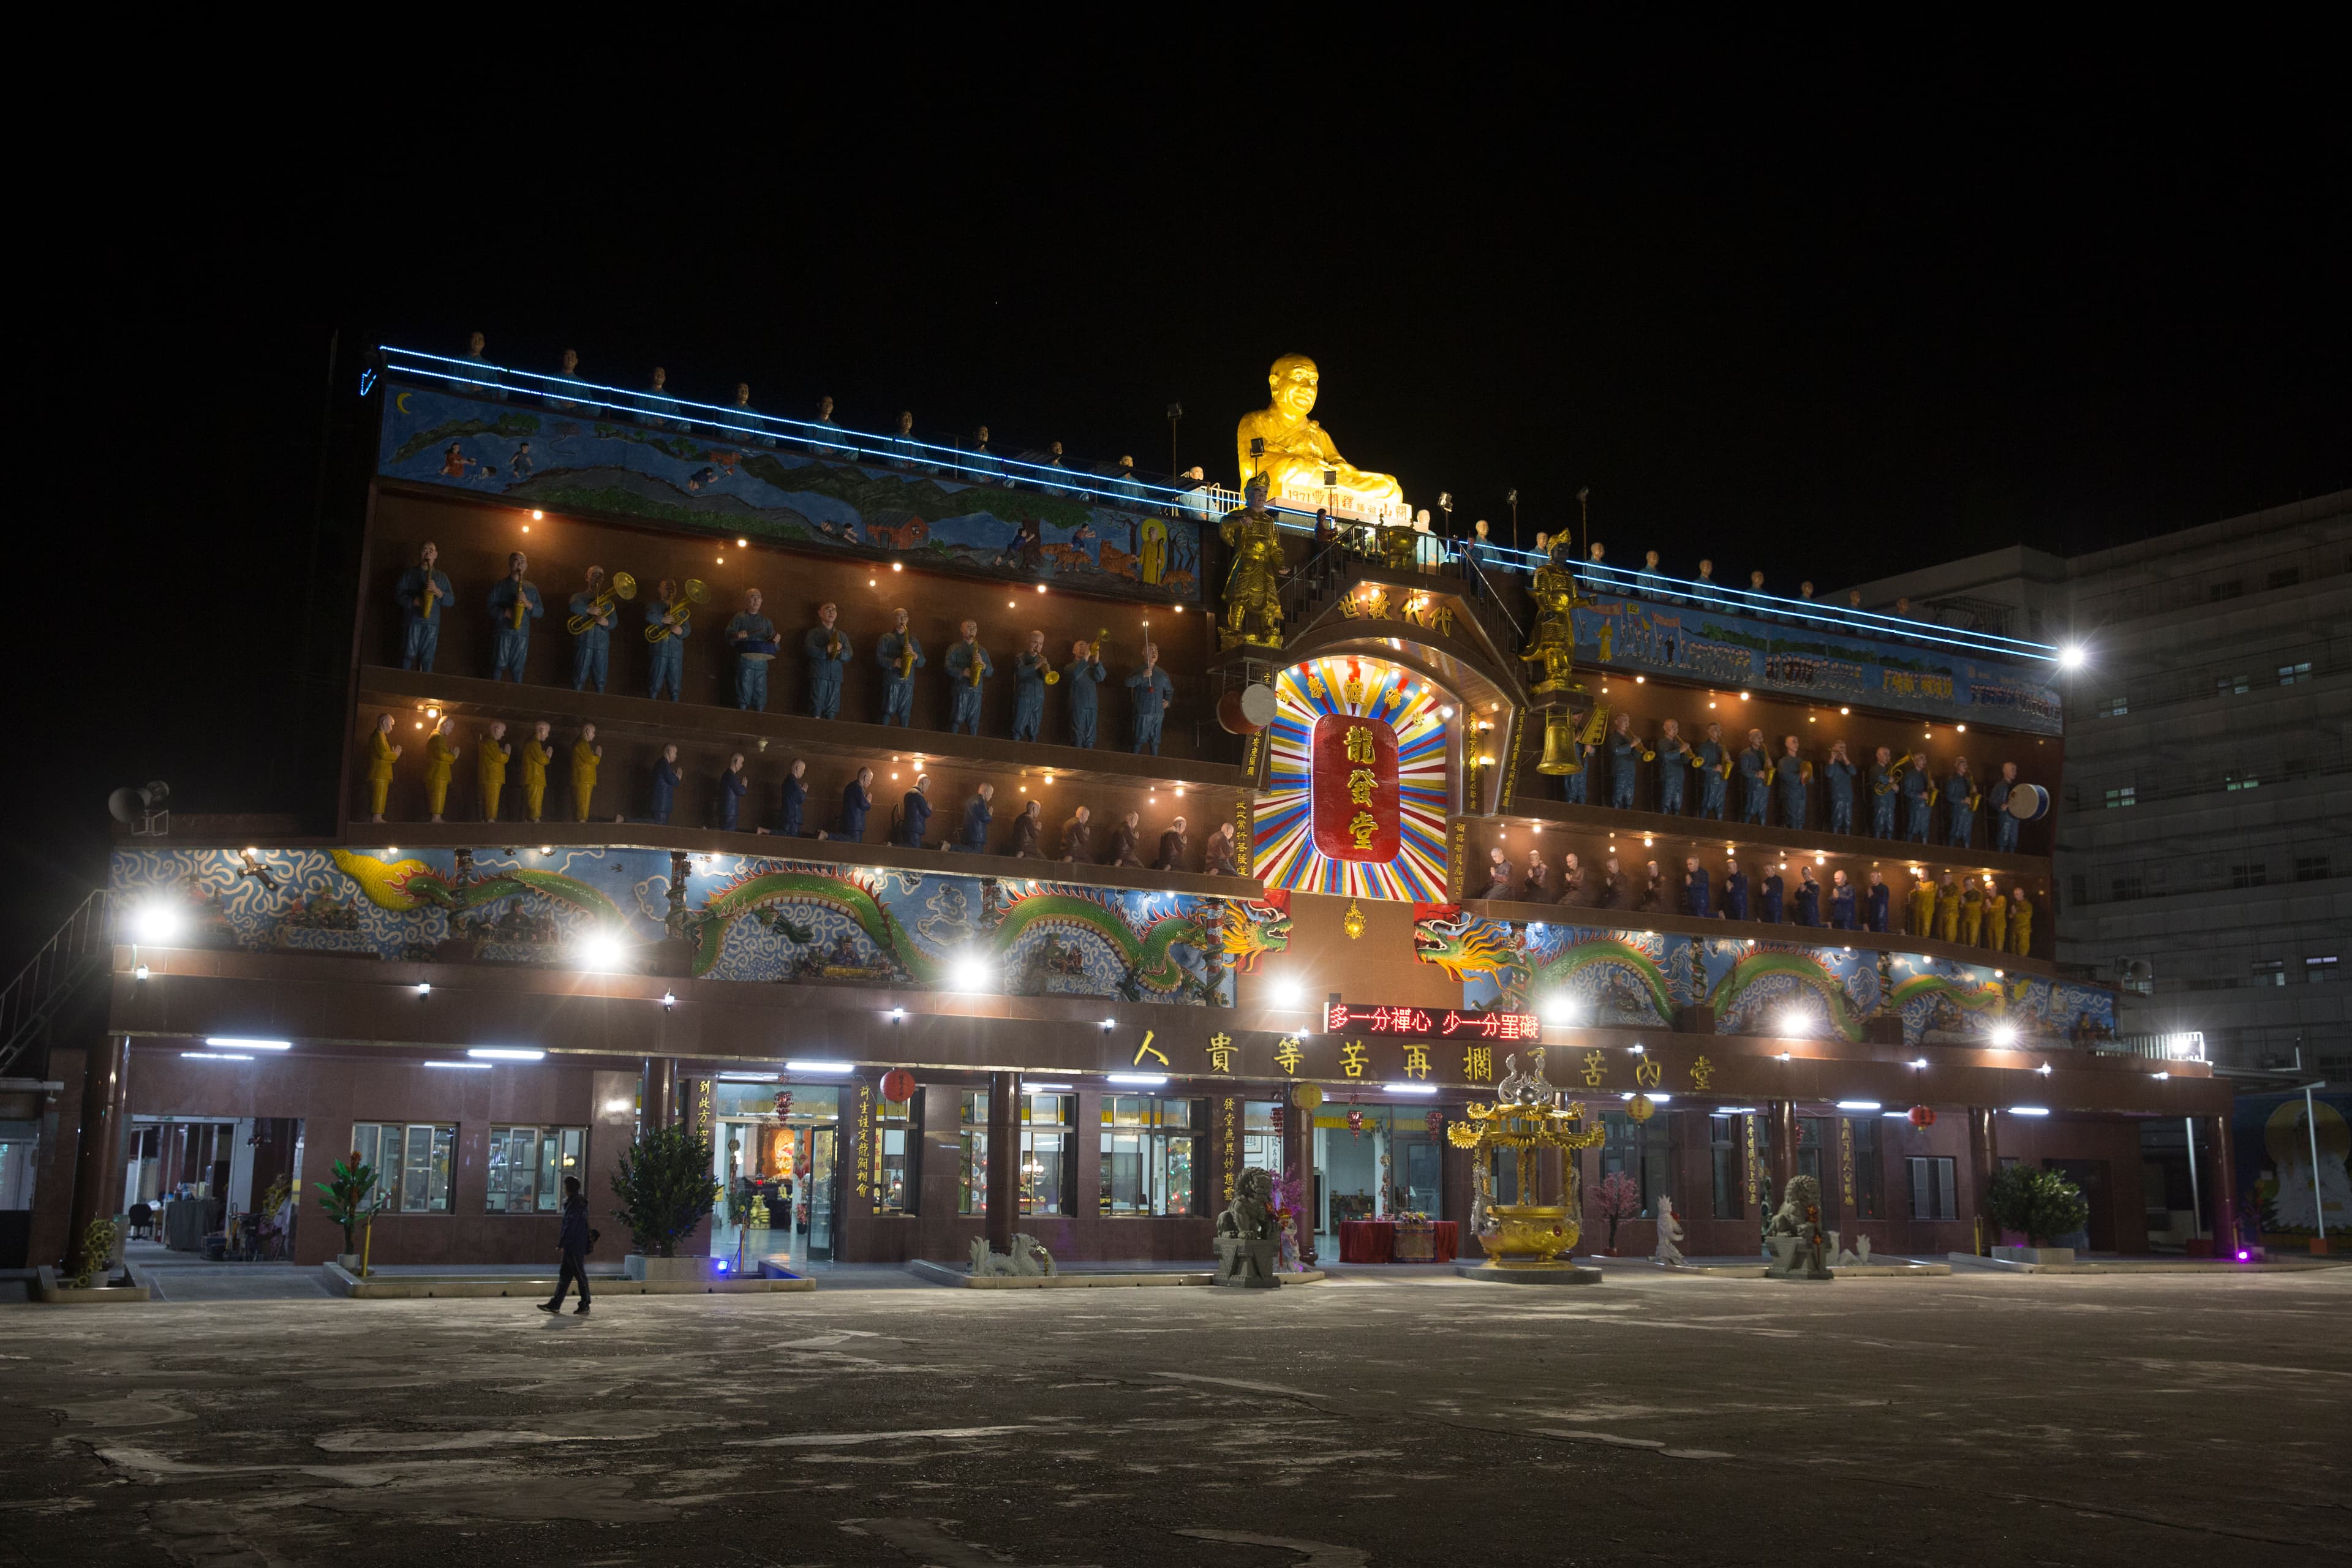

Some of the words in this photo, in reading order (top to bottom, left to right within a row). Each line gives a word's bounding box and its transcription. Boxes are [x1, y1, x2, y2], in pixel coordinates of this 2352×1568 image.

[1289, 489, 1310, 502] 1971
[1343, 725, 1379, 851] 龍發堂
[1329, 1004, 1432, 1033] 多一分禪心
[1442, 1010, 1539, 1039] 少一分罣礙
